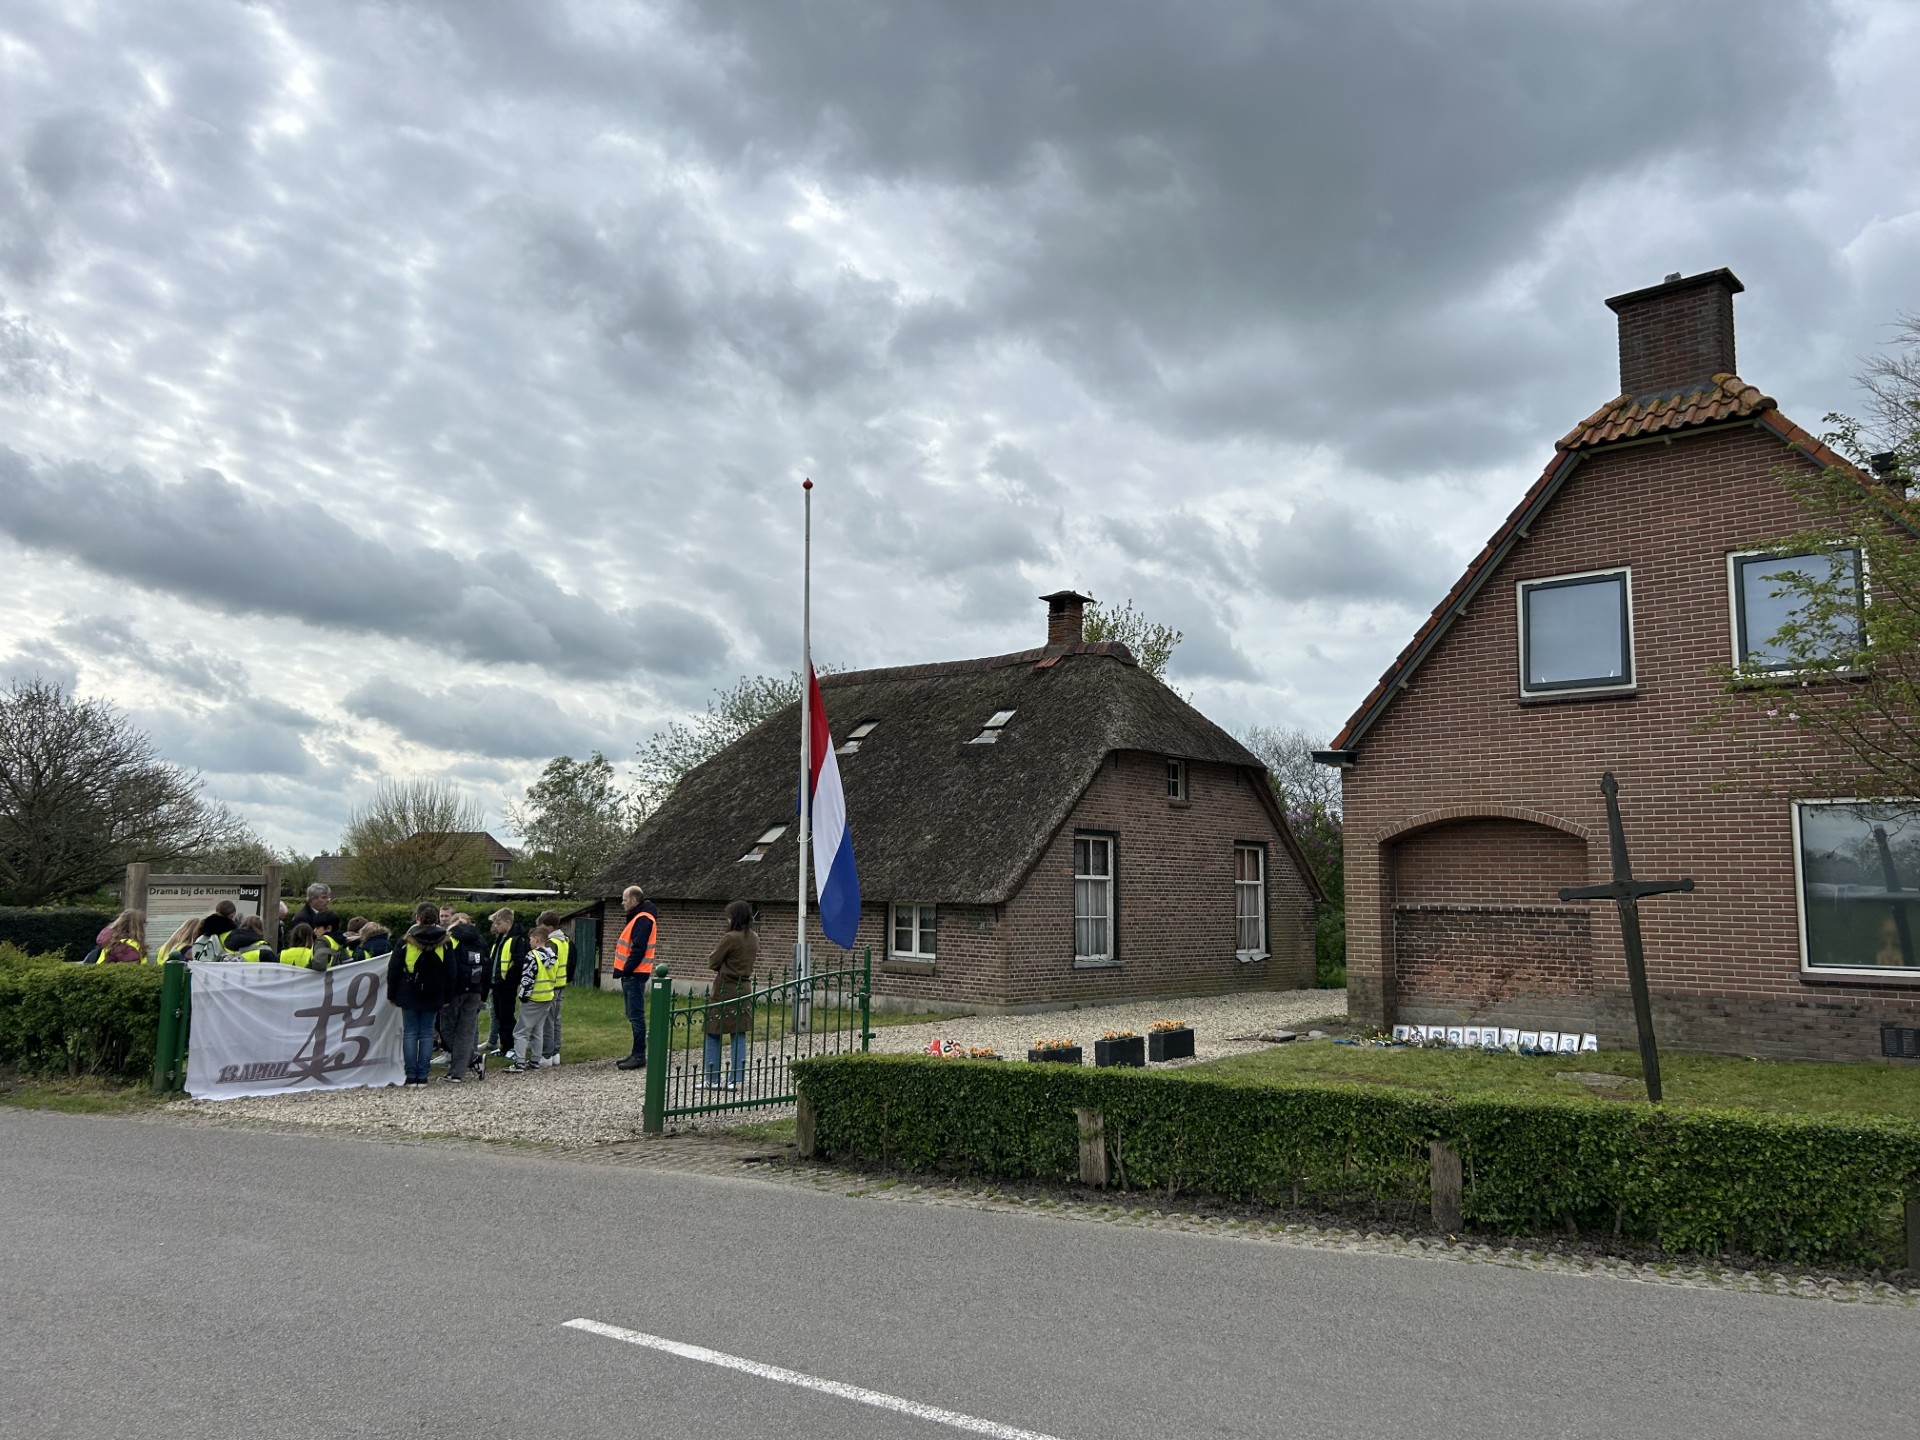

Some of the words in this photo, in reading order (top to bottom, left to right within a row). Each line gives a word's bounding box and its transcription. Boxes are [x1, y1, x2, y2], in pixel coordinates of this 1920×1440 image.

[149, 887, 179, 895] Drama
[180, 887, 191, 896] bij
[193, 887, 204, 895] de
[217, 1064, 240, 1083] 13
[238, 1062, 290, 1081] APRIL
